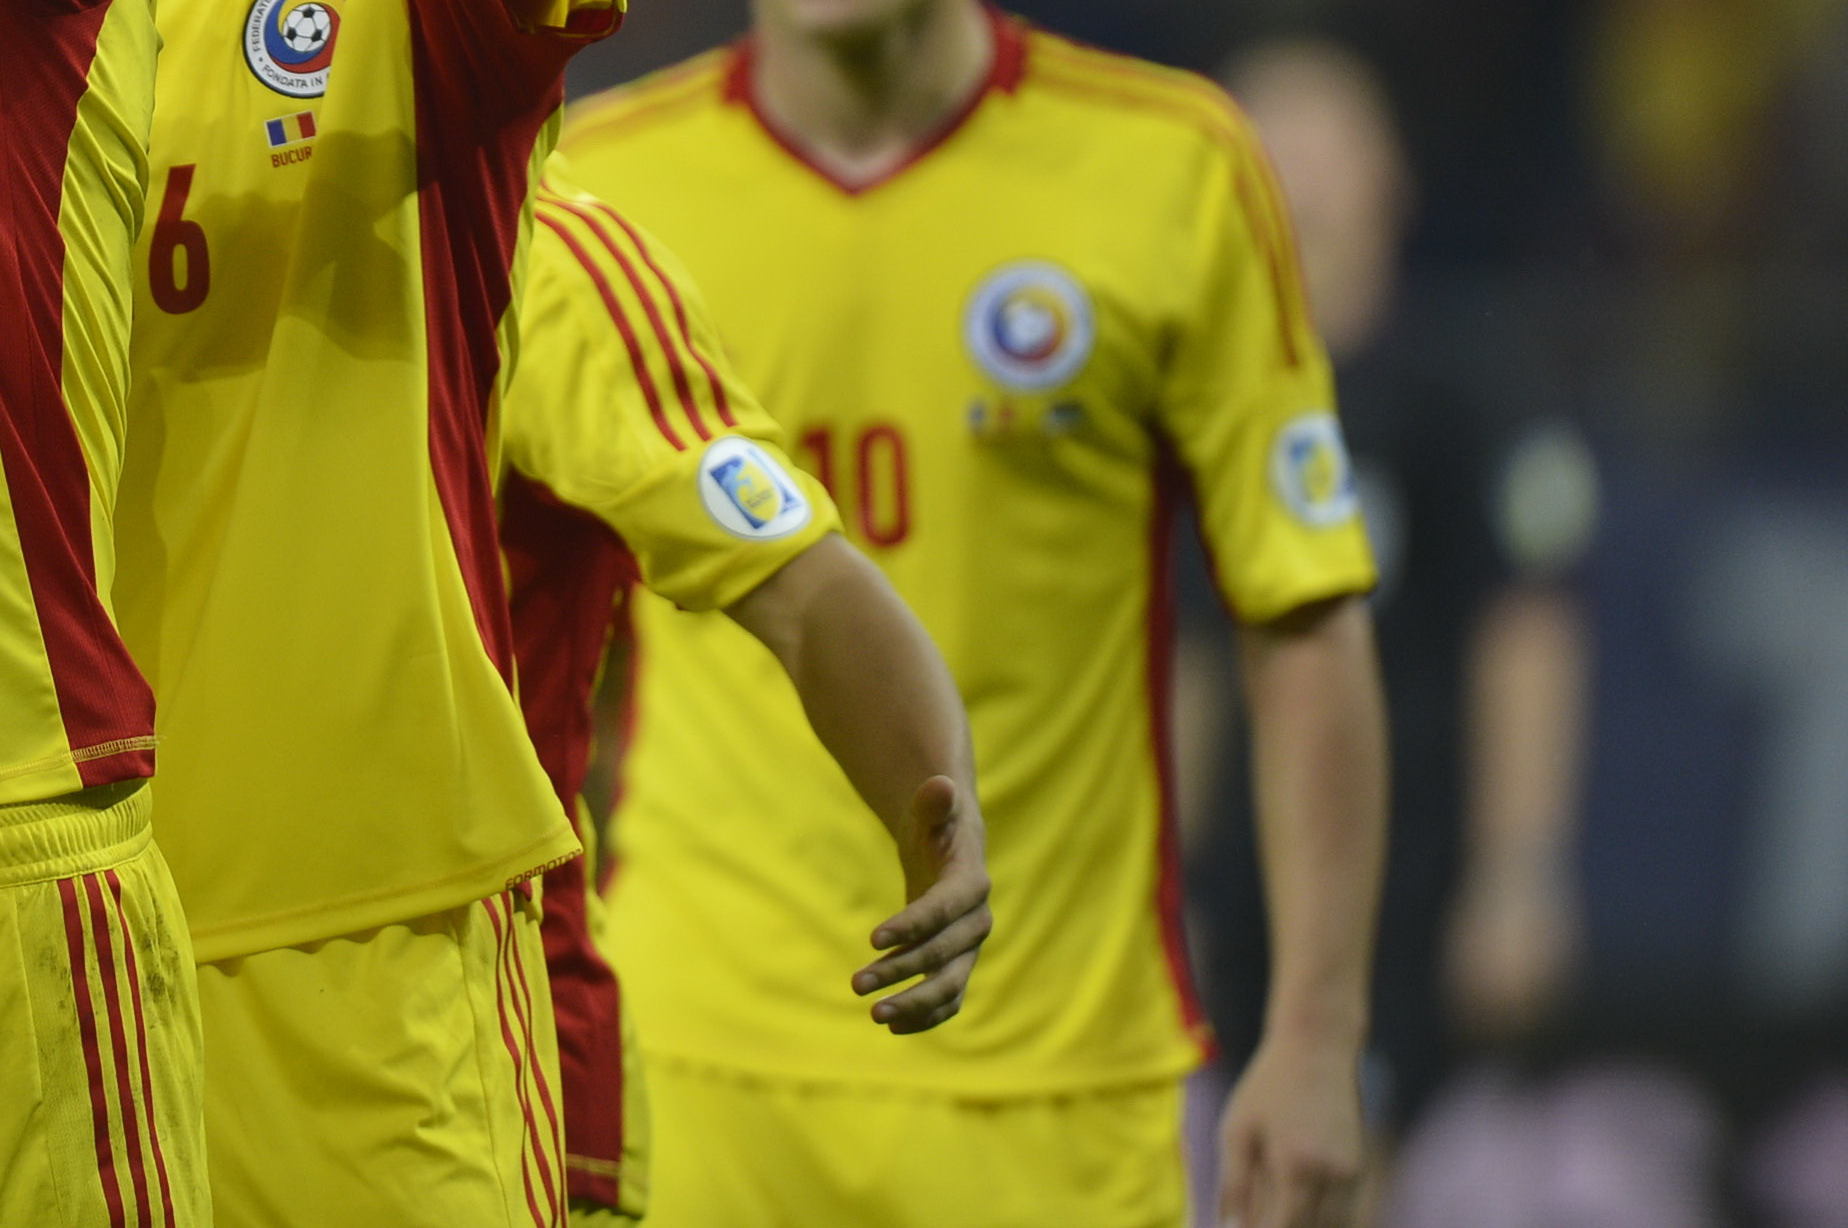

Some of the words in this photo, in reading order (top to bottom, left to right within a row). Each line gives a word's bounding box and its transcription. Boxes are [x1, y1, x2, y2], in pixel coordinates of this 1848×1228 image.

[261, 64, 309, 89] FONDATA
[311, 76, 323, 88] IN
[148, 162, 211, 315] 6
[800, 424, 910, 550] 10
